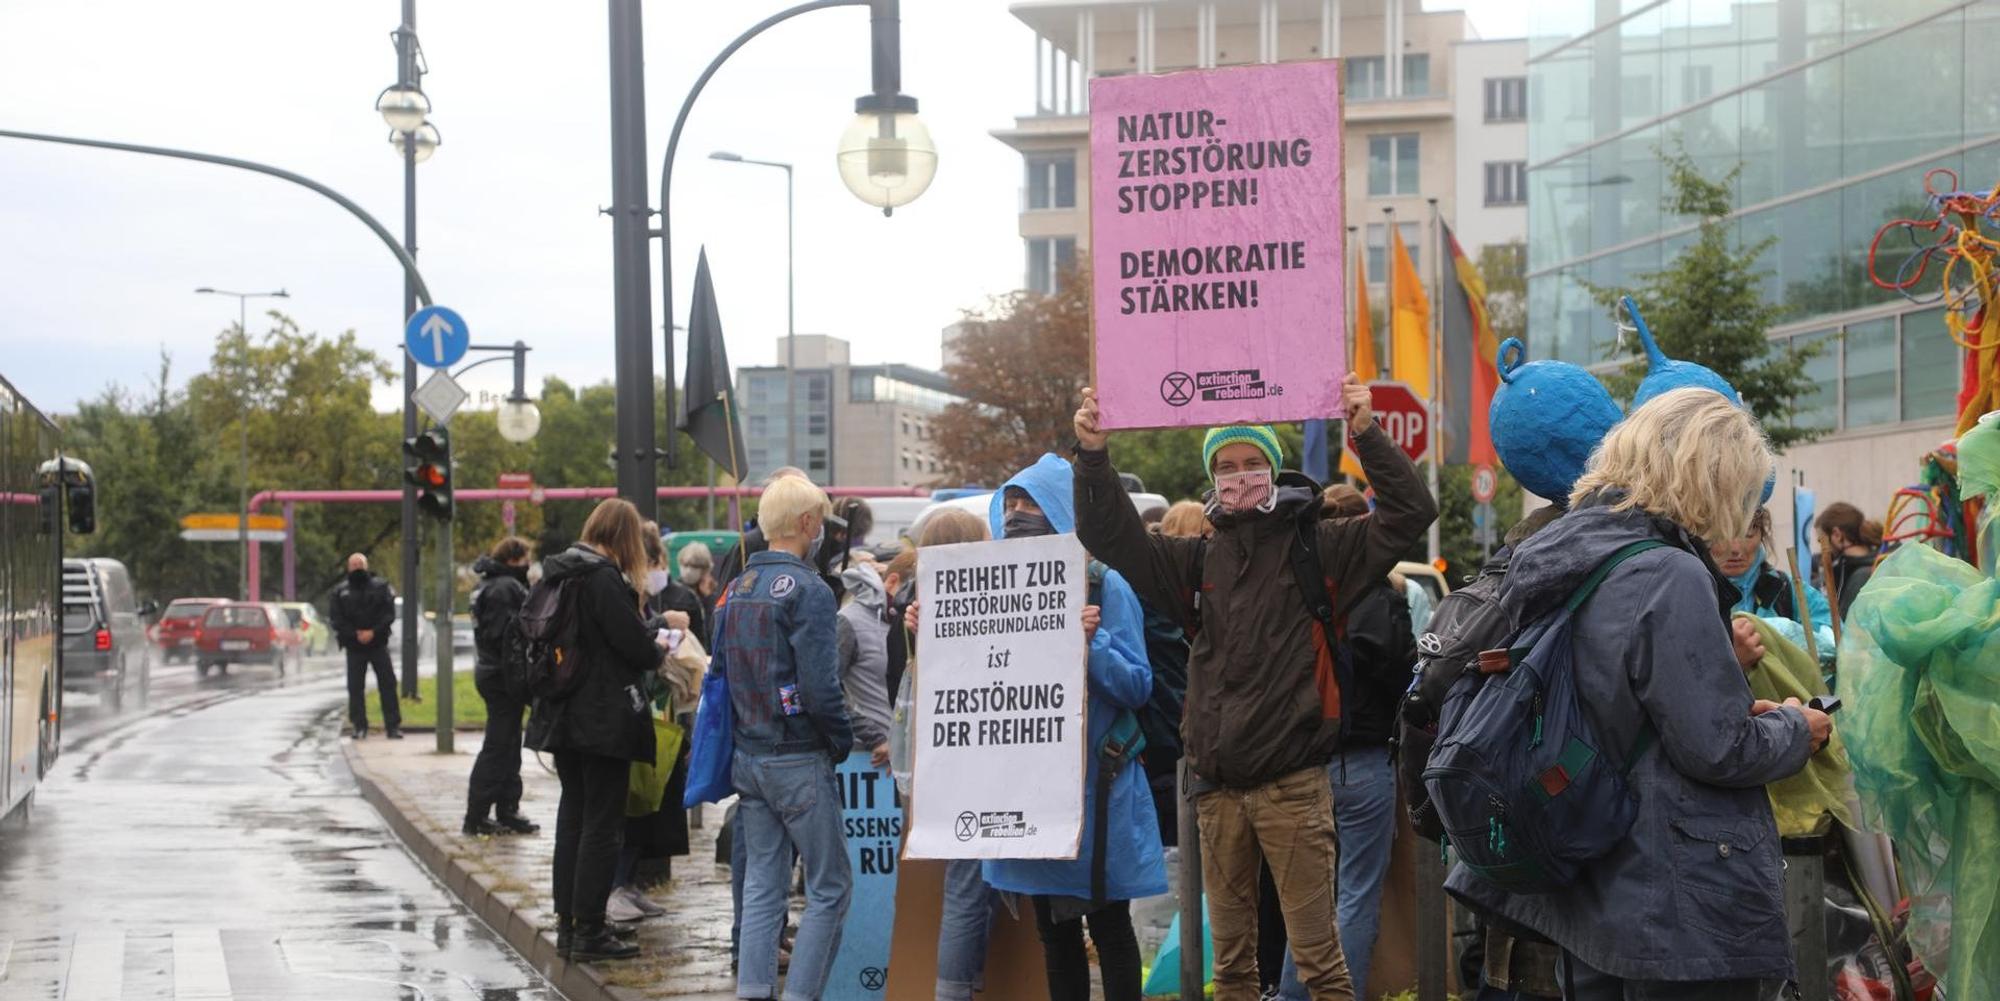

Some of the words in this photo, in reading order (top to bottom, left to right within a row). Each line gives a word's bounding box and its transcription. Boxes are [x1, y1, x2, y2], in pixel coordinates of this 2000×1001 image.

[1118, 109, 1227, 143] NATUR-
[1118, 138, 1312, 178] ZERSTÖRUNG
[1118, 178, 1258, 214] STOPPEN!
[1120, 241, 1306, 279] DEMOKRATIE
[1120, 279, 1259, 315] STÄRKEN!
[1200, 371, 1252, 386] extinction
[1371, 411, 1423, 448] TOP
[936, 563, 1018, 595] FREIHEIT
[1026, 560, 1066, 588] ZUR
[935, 592, 1033, 619] ZERSTÖRUNG
[1038, 591, 1066, 611] DER
[935, 614, 1065, 639] LEBENSGRUNDLAGEN
[987, 645, 1011, 668] ist
[934, 681, 1064, 715] ZERSTÖRUNG
[933, 721, 971, 747] DER
[978, 716, 1065, 746] FREIHEIT
[845, 817, 900, 838] SSENS
[860, 841, 894, 875] RÜ
